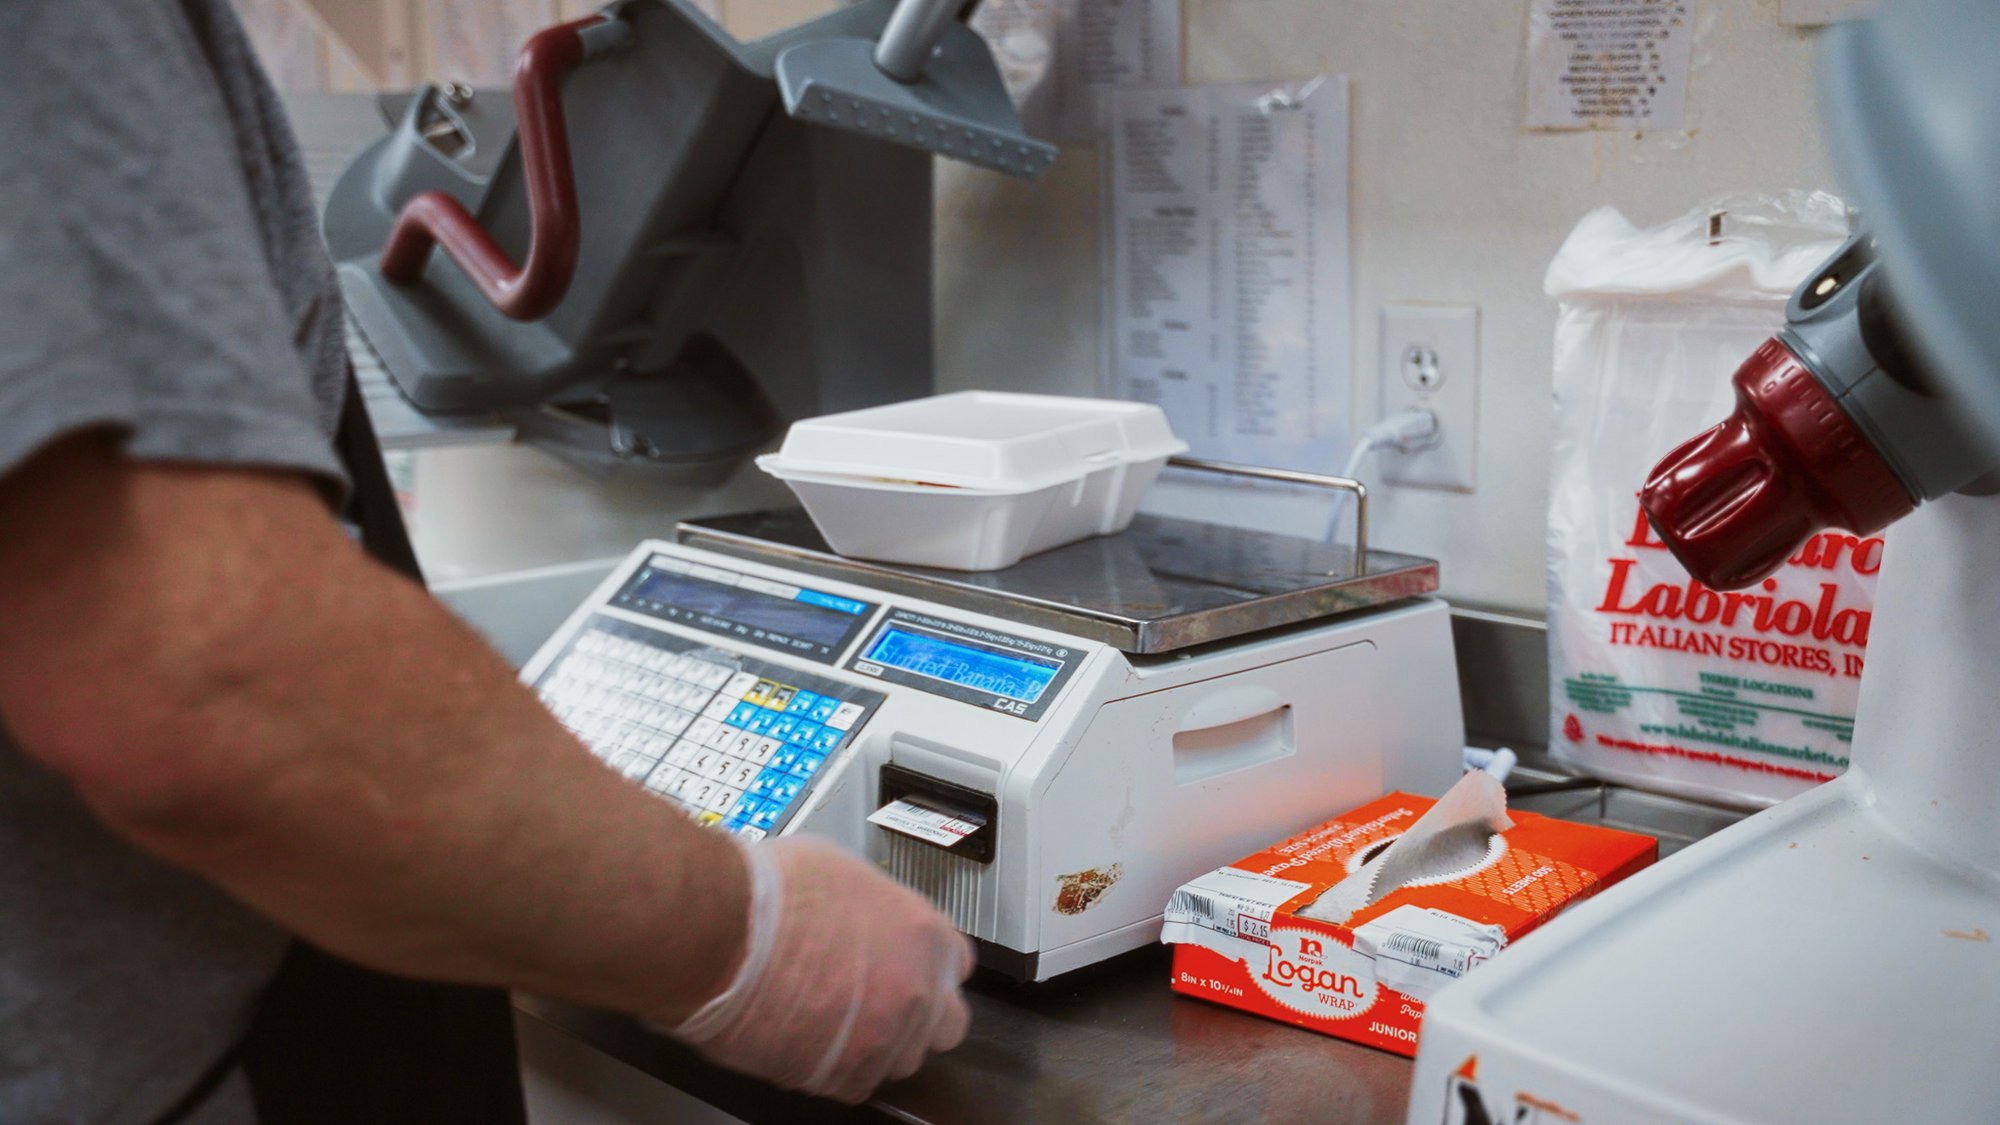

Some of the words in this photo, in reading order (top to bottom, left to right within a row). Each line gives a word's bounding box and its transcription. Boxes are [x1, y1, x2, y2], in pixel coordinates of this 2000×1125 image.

[1595, 558, 1872, 647] Labriola
[1609, 622, 1724, 657] ITALIAN
[1728, 636, 1838, 677] STORES,
[877, 645, 950, 678] Stuffed
[952, 662, 1014, 697] Banana
[1699, 672, 1741, 688] THREE
[1743, 677, 1814, 700] LOCATIONS
[994, 698, 1029, 715] CAS
[716, 730, 729, 744] 7
[759, 743, 770, 758] 9
[718, 761, 731, 775] 5
[676, 777, 688, 792] 1
[699, 785, 710, 800] 2
[719, 792, 731, 807] 3
[1260, 857, 1307, 877] Pape
[1502, 875, 1538, 895] SHEETS
[1251, 922, 1268, 938] 2.15
[1299, 955, 1323, 966] Norpak
[1262, 944, 1364, 998] Logan
[1318, 993, 1355, 1012] WRAP
[1369, 1021, 1418, 1043] JUNIOR
